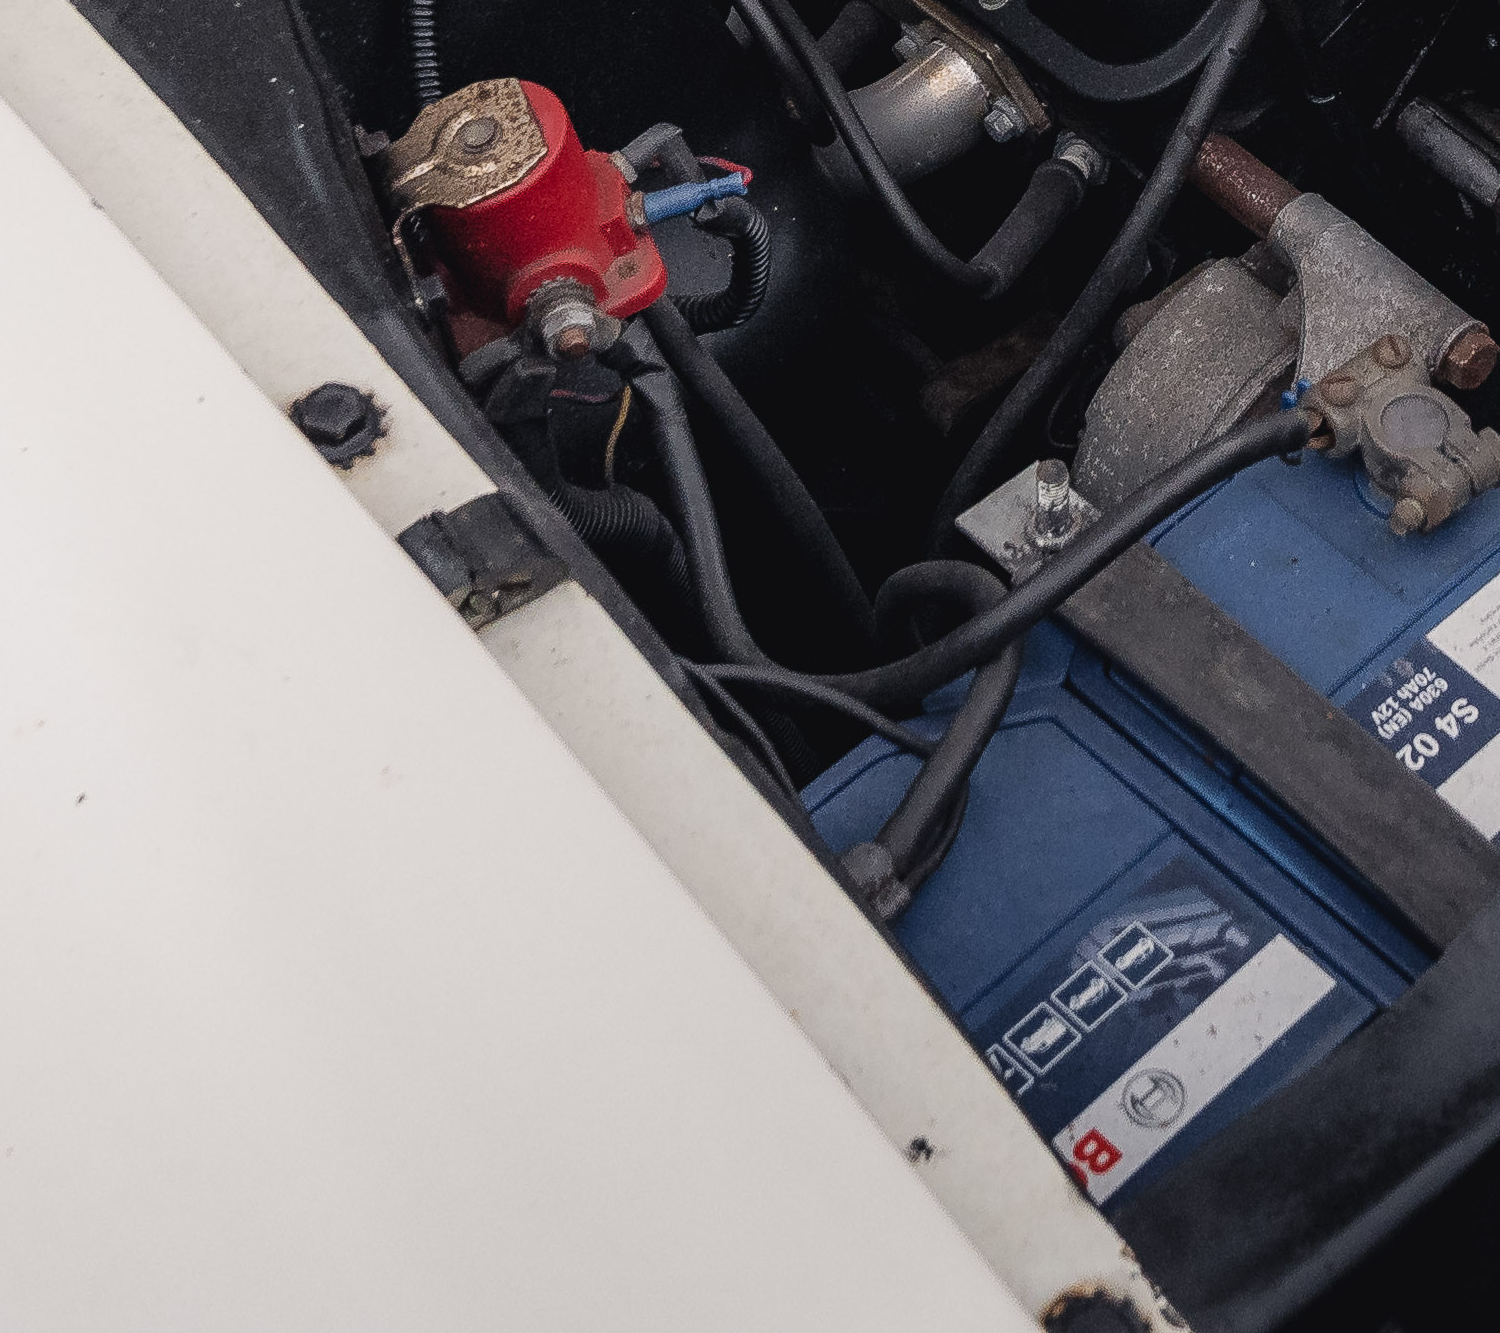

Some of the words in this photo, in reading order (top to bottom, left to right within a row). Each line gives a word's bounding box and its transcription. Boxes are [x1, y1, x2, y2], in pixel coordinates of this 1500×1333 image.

[1371, 696, 1400, 726] 12V
[1434, 697, 1479, 740] S4
[1068, 1128, 1124, 1189] B
